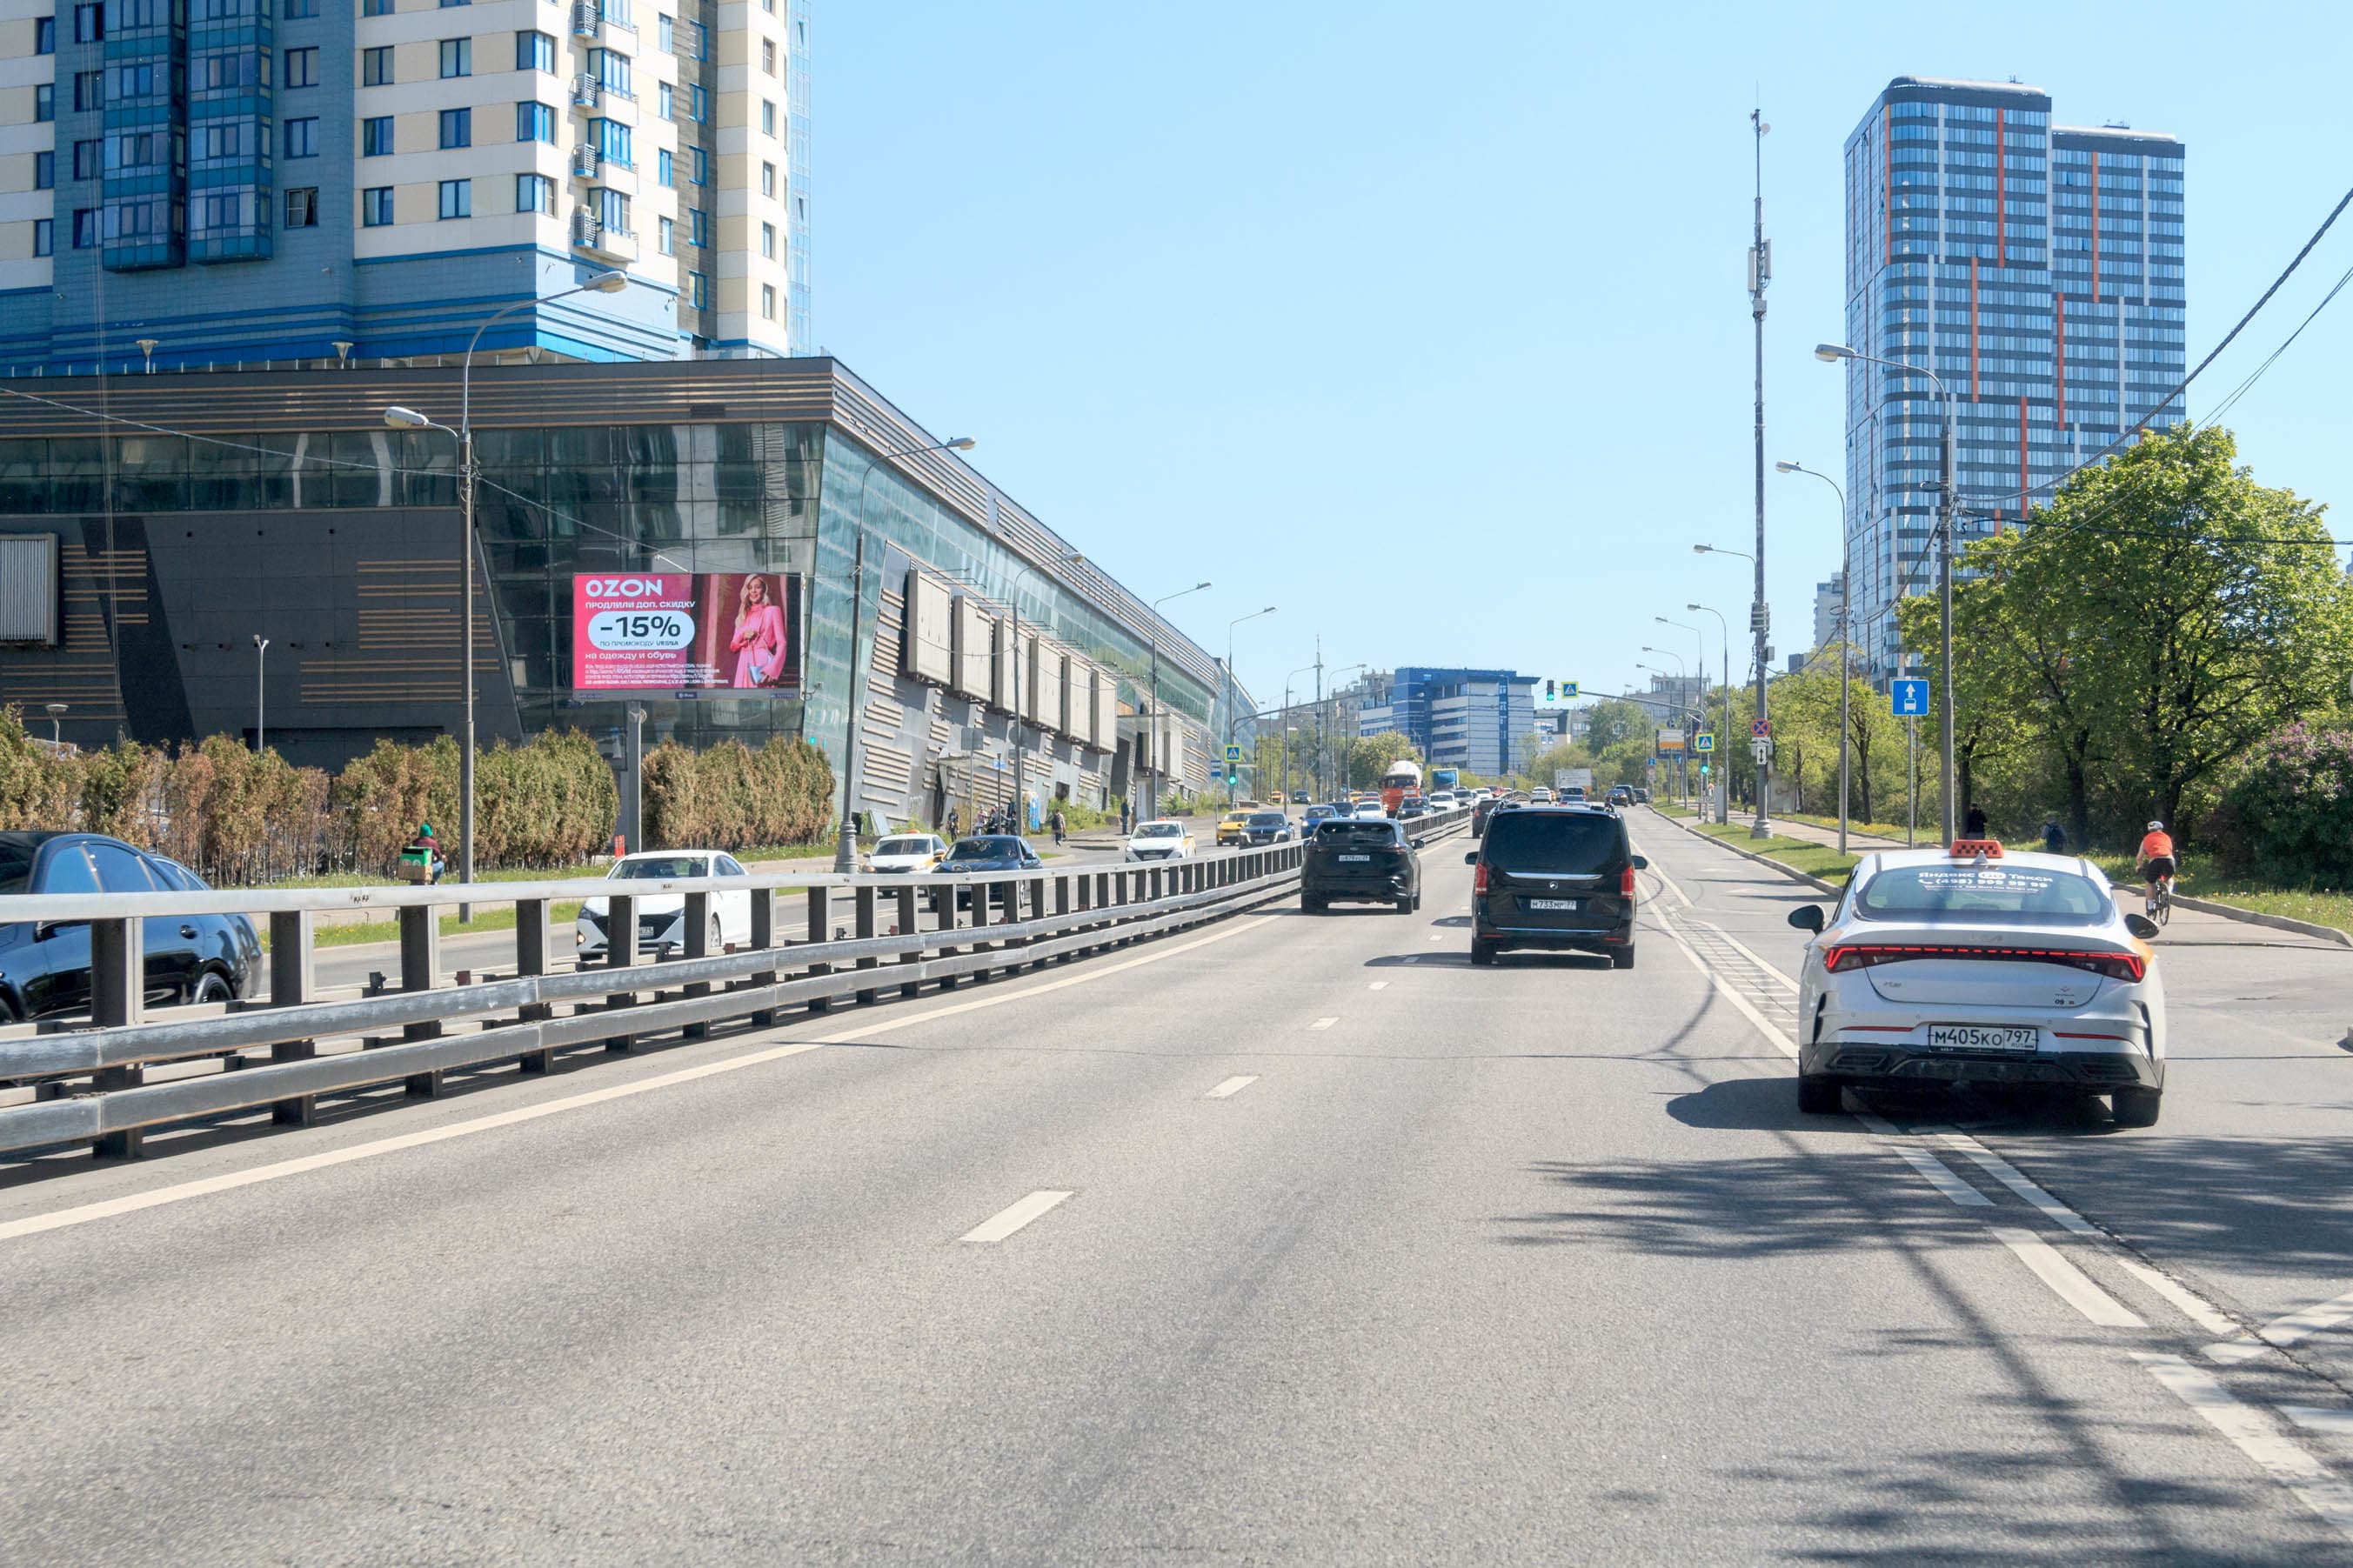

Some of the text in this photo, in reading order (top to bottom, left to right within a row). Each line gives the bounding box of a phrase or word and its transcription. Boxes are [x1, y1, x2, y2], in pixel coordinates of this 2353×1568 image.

[585, 578, 663, 597] OZON
[585, 600, 635, 609] ПРОДЛИЛИ
[636, 600, 658, 609] ДОП.
[647, 651, 677, 660] обувь
[2009, 873, 2054, 883] Такси
[2005, 1030, 2031, 1043] 797
